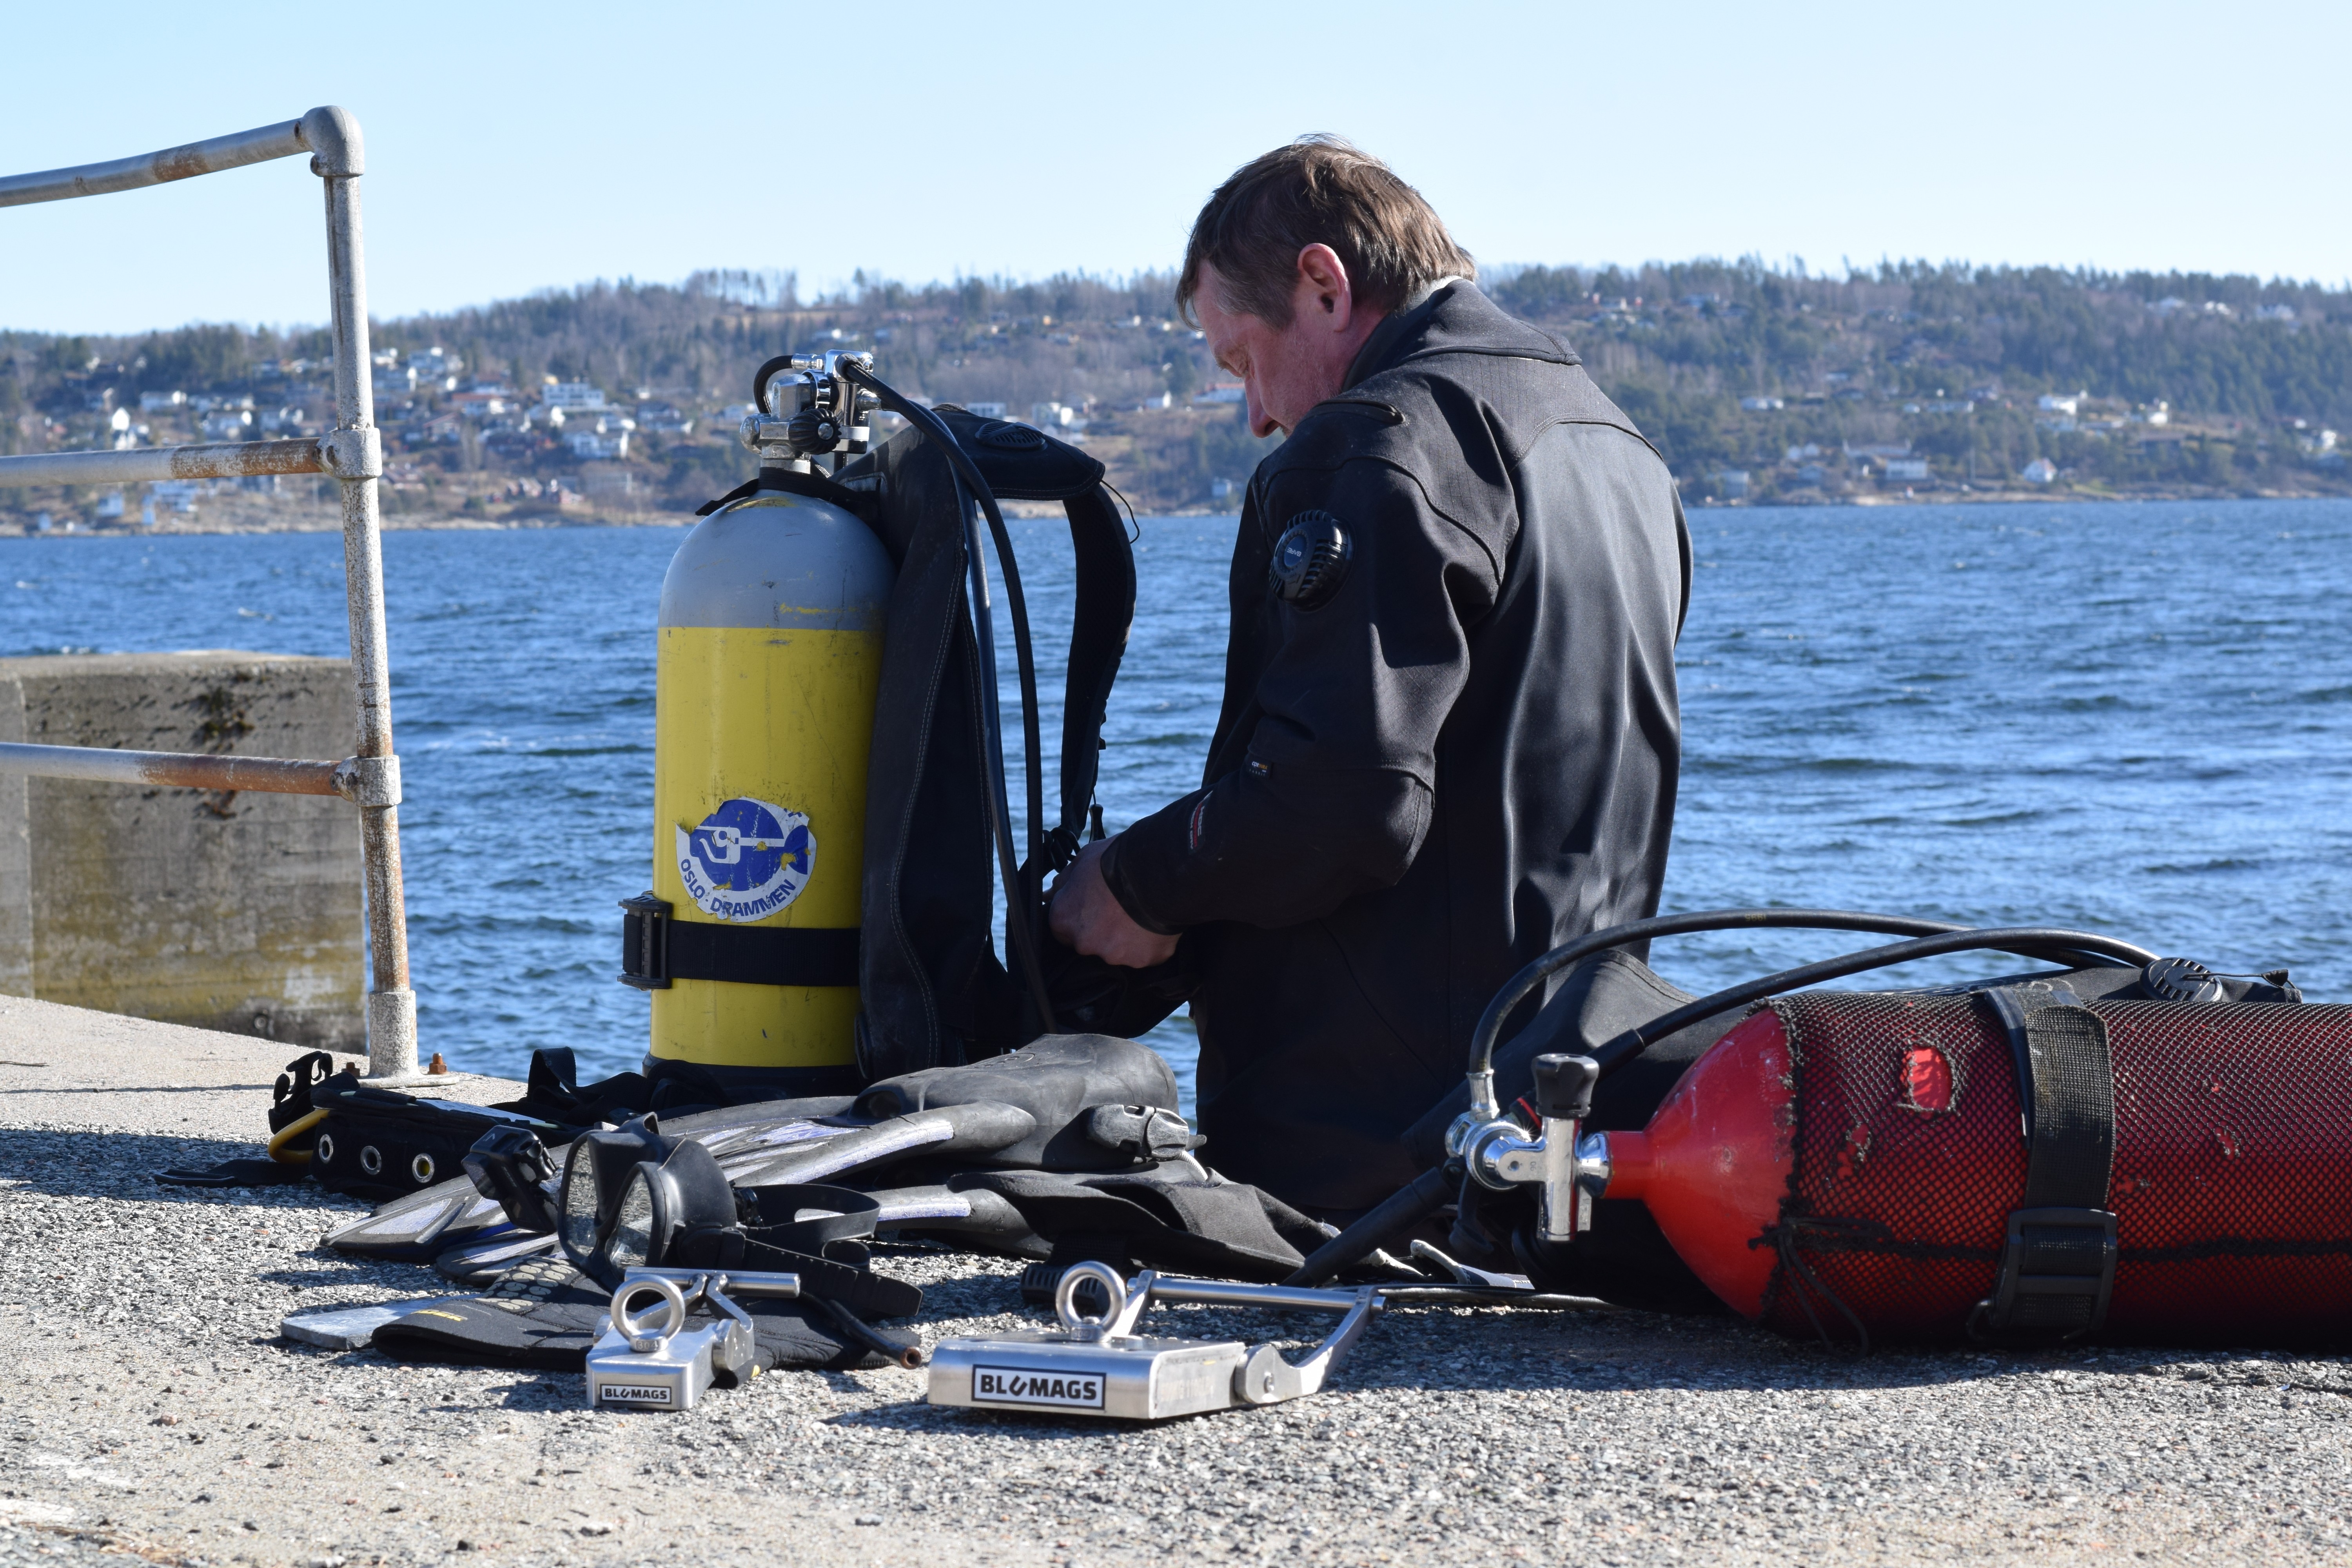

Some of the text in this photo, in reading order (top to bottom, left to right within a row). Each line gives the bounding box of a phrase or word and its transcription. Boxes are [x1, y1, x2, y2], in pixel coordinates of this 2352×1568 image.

[1287, 547, 1302, 557] BARE
[681, 859, 796, 916] OSLO DRAMMEN
[411, 1309, 468, 1322] DER
[637, 1341, 658, 1350] 304
[604, 1388, 667, 1399] BLUMAGS
[980, 1375, 1097, 1401] BLUMAGS
